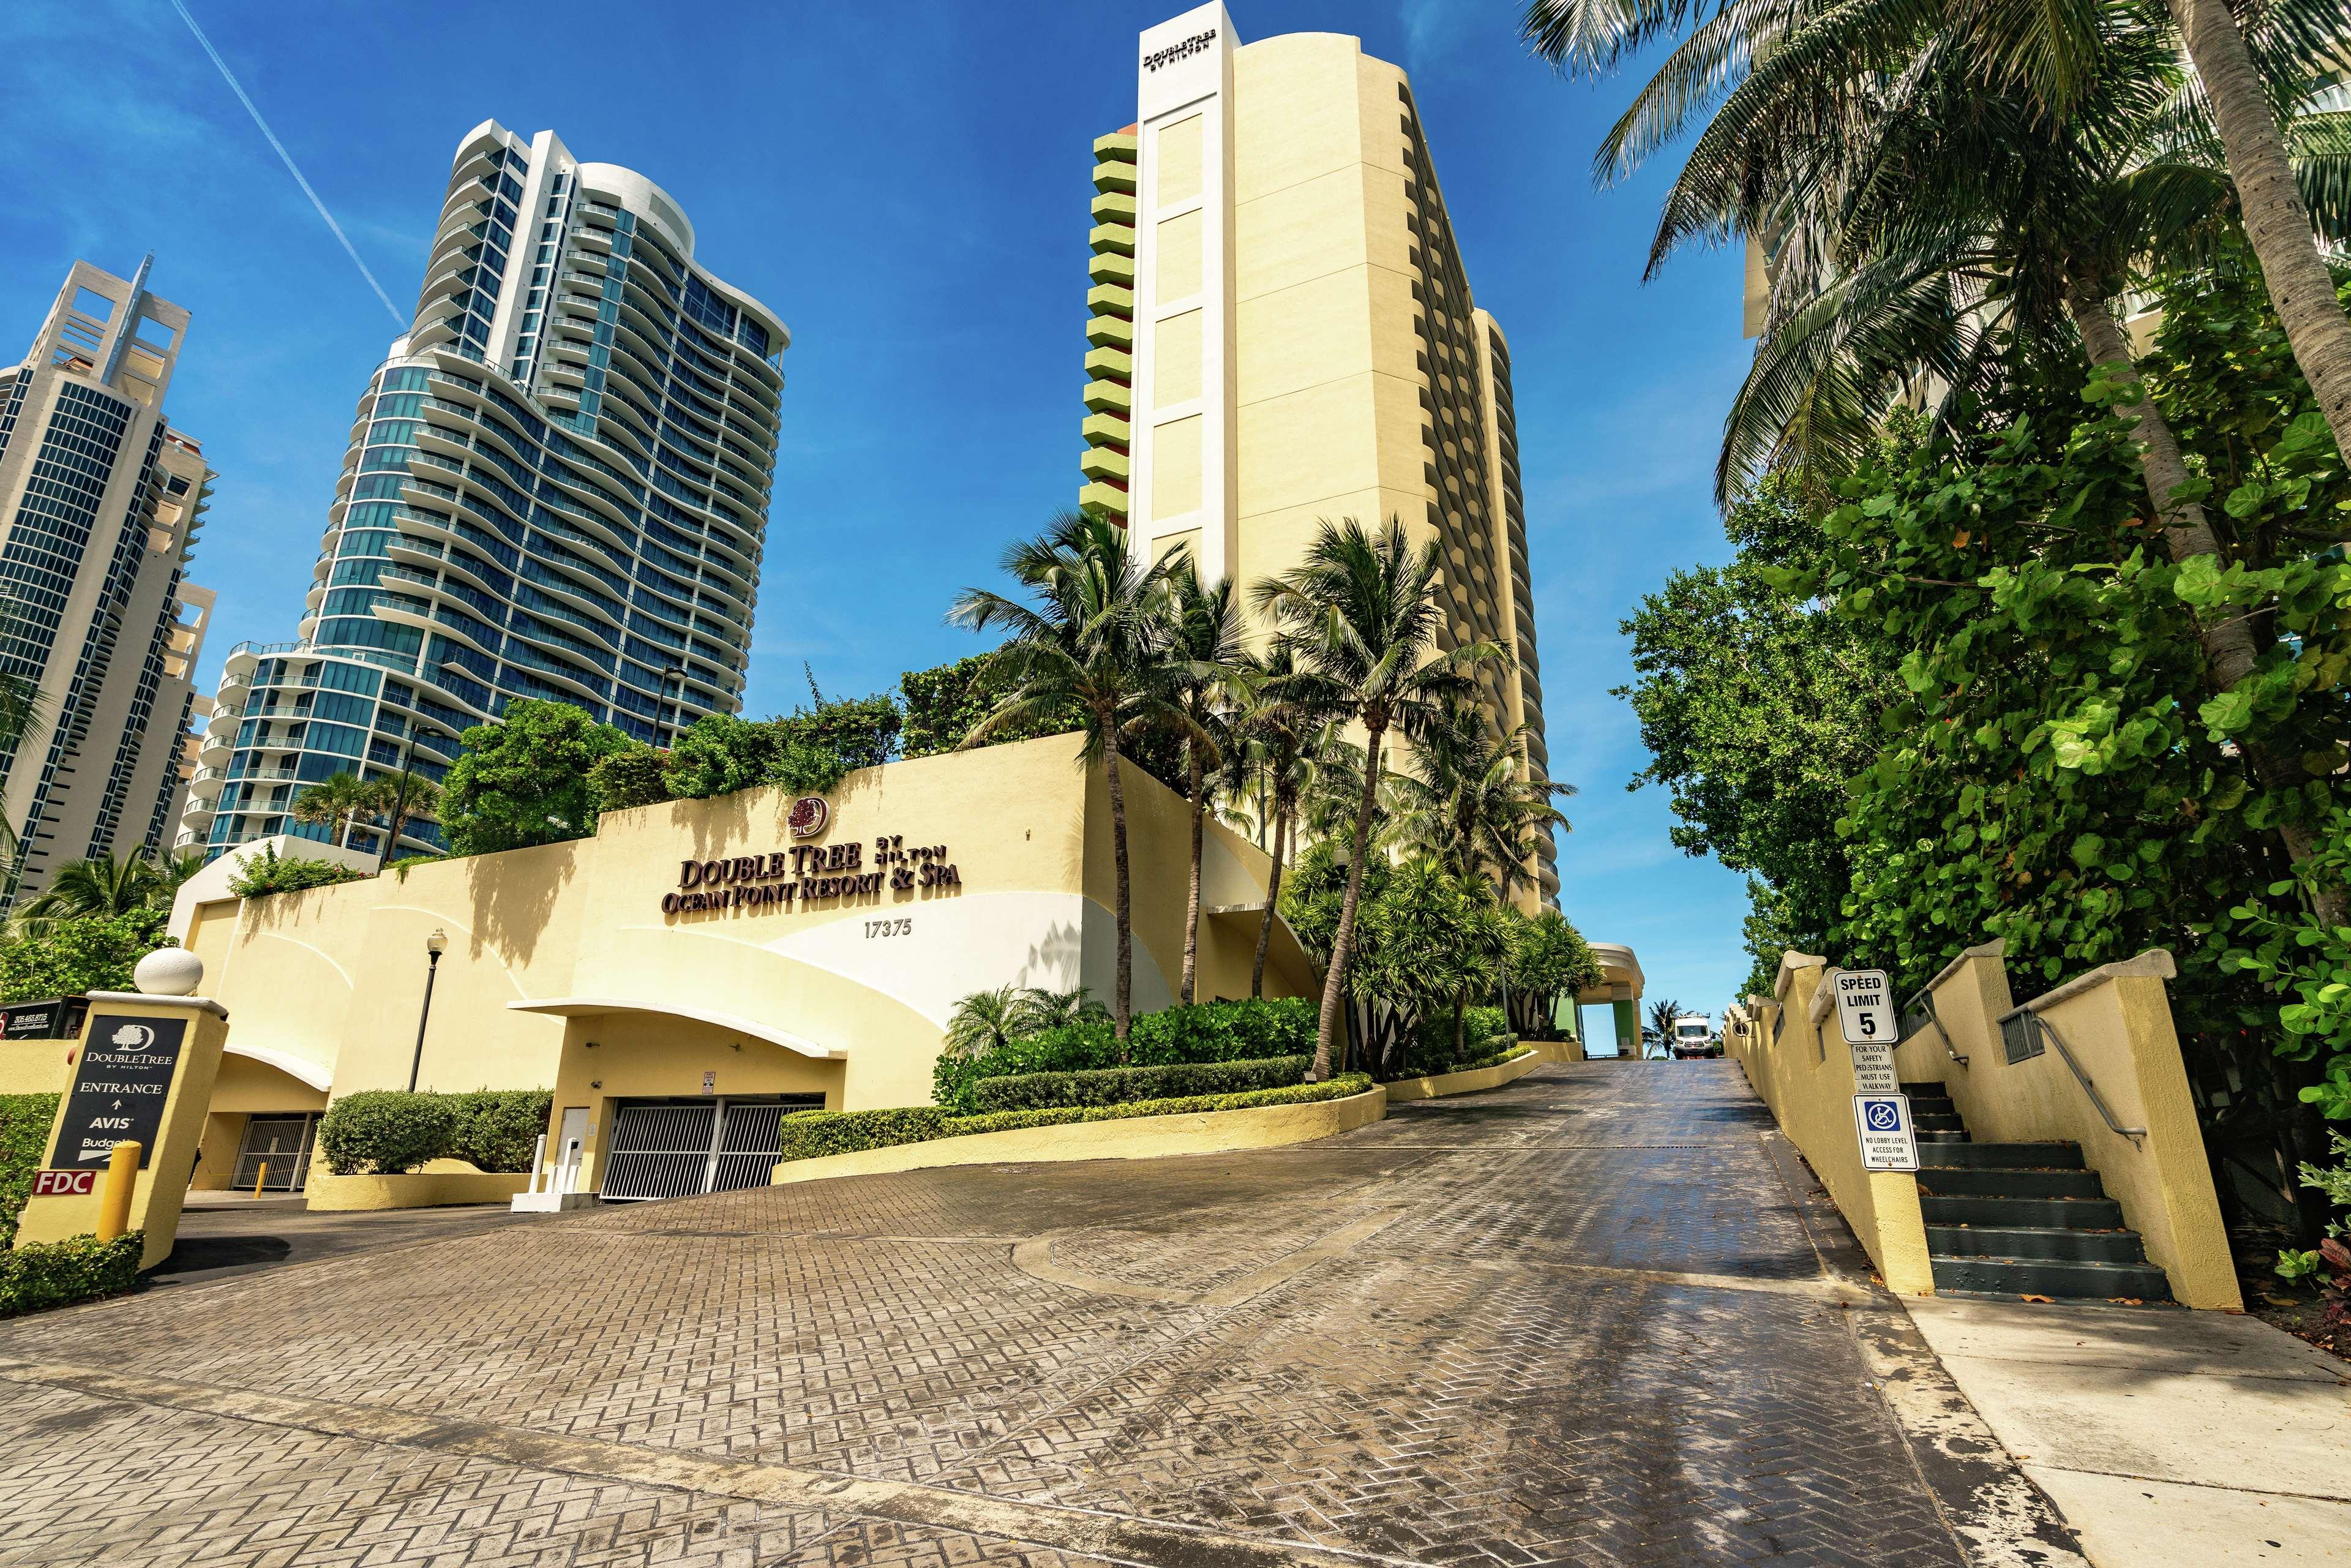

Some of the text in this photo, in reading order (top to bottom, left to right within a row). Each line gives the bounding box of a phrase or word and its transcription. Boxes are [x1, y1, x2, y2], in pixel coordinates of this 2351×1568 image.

[1169, 41, 1209, 64] HILTON
[876, 835, 903, 849] BY
[874, 845, 947, 865] HILTON
[678, 842, 862, 888] DOUBLE TREE
[662, 862, 962, 914] OCEAN POINT RESORT & SPA
[864, 918, 912, 939] 17375
[1840, 978, 1881, 991] SPEED
[1847, 994, 1880, 1007] LIMIT
[1859, 1013, 1876, 1035] 5
[86, 1052, 173, 1065] DOUBLETREE
[79, 1082, 162, 1094] ENTRANCE
[89, 1117, 130, 1129] AVIS
[82, 1138, 126, 1150] Budg
[36, 1172, 92, 1193] FDC
